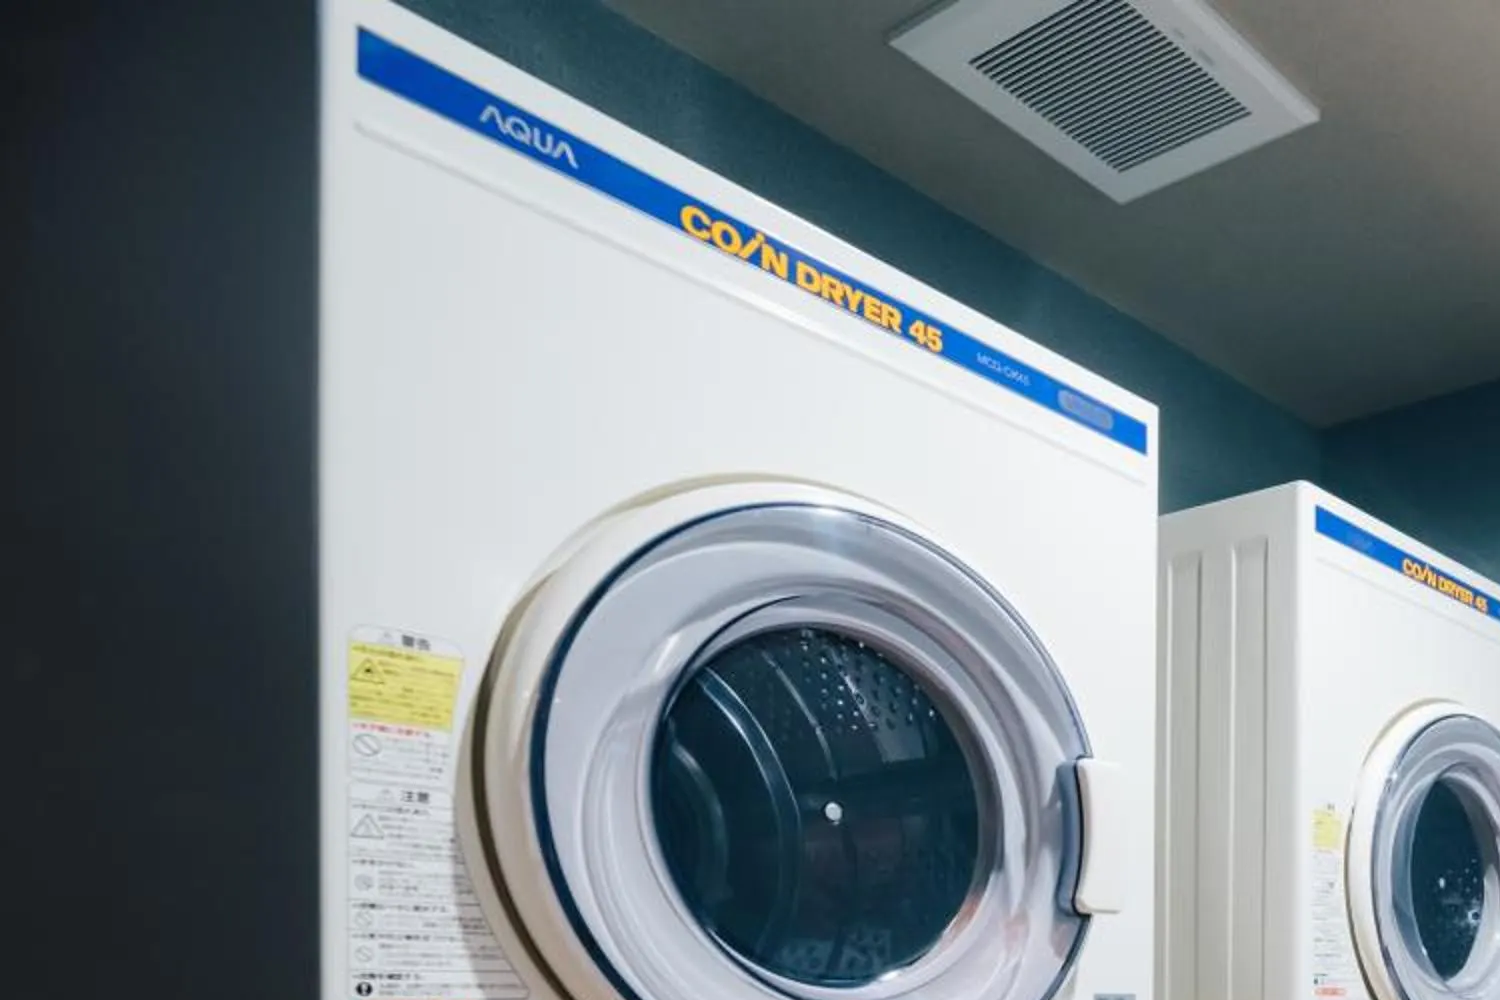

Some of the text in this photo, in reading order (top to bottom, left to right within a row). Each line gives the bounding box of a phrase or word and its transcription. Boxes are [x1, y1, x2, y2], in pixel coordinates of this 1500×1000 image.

[480, 105, 579, 169] AQUA
[680, 204, 944, 354] COIN DRYER 45
